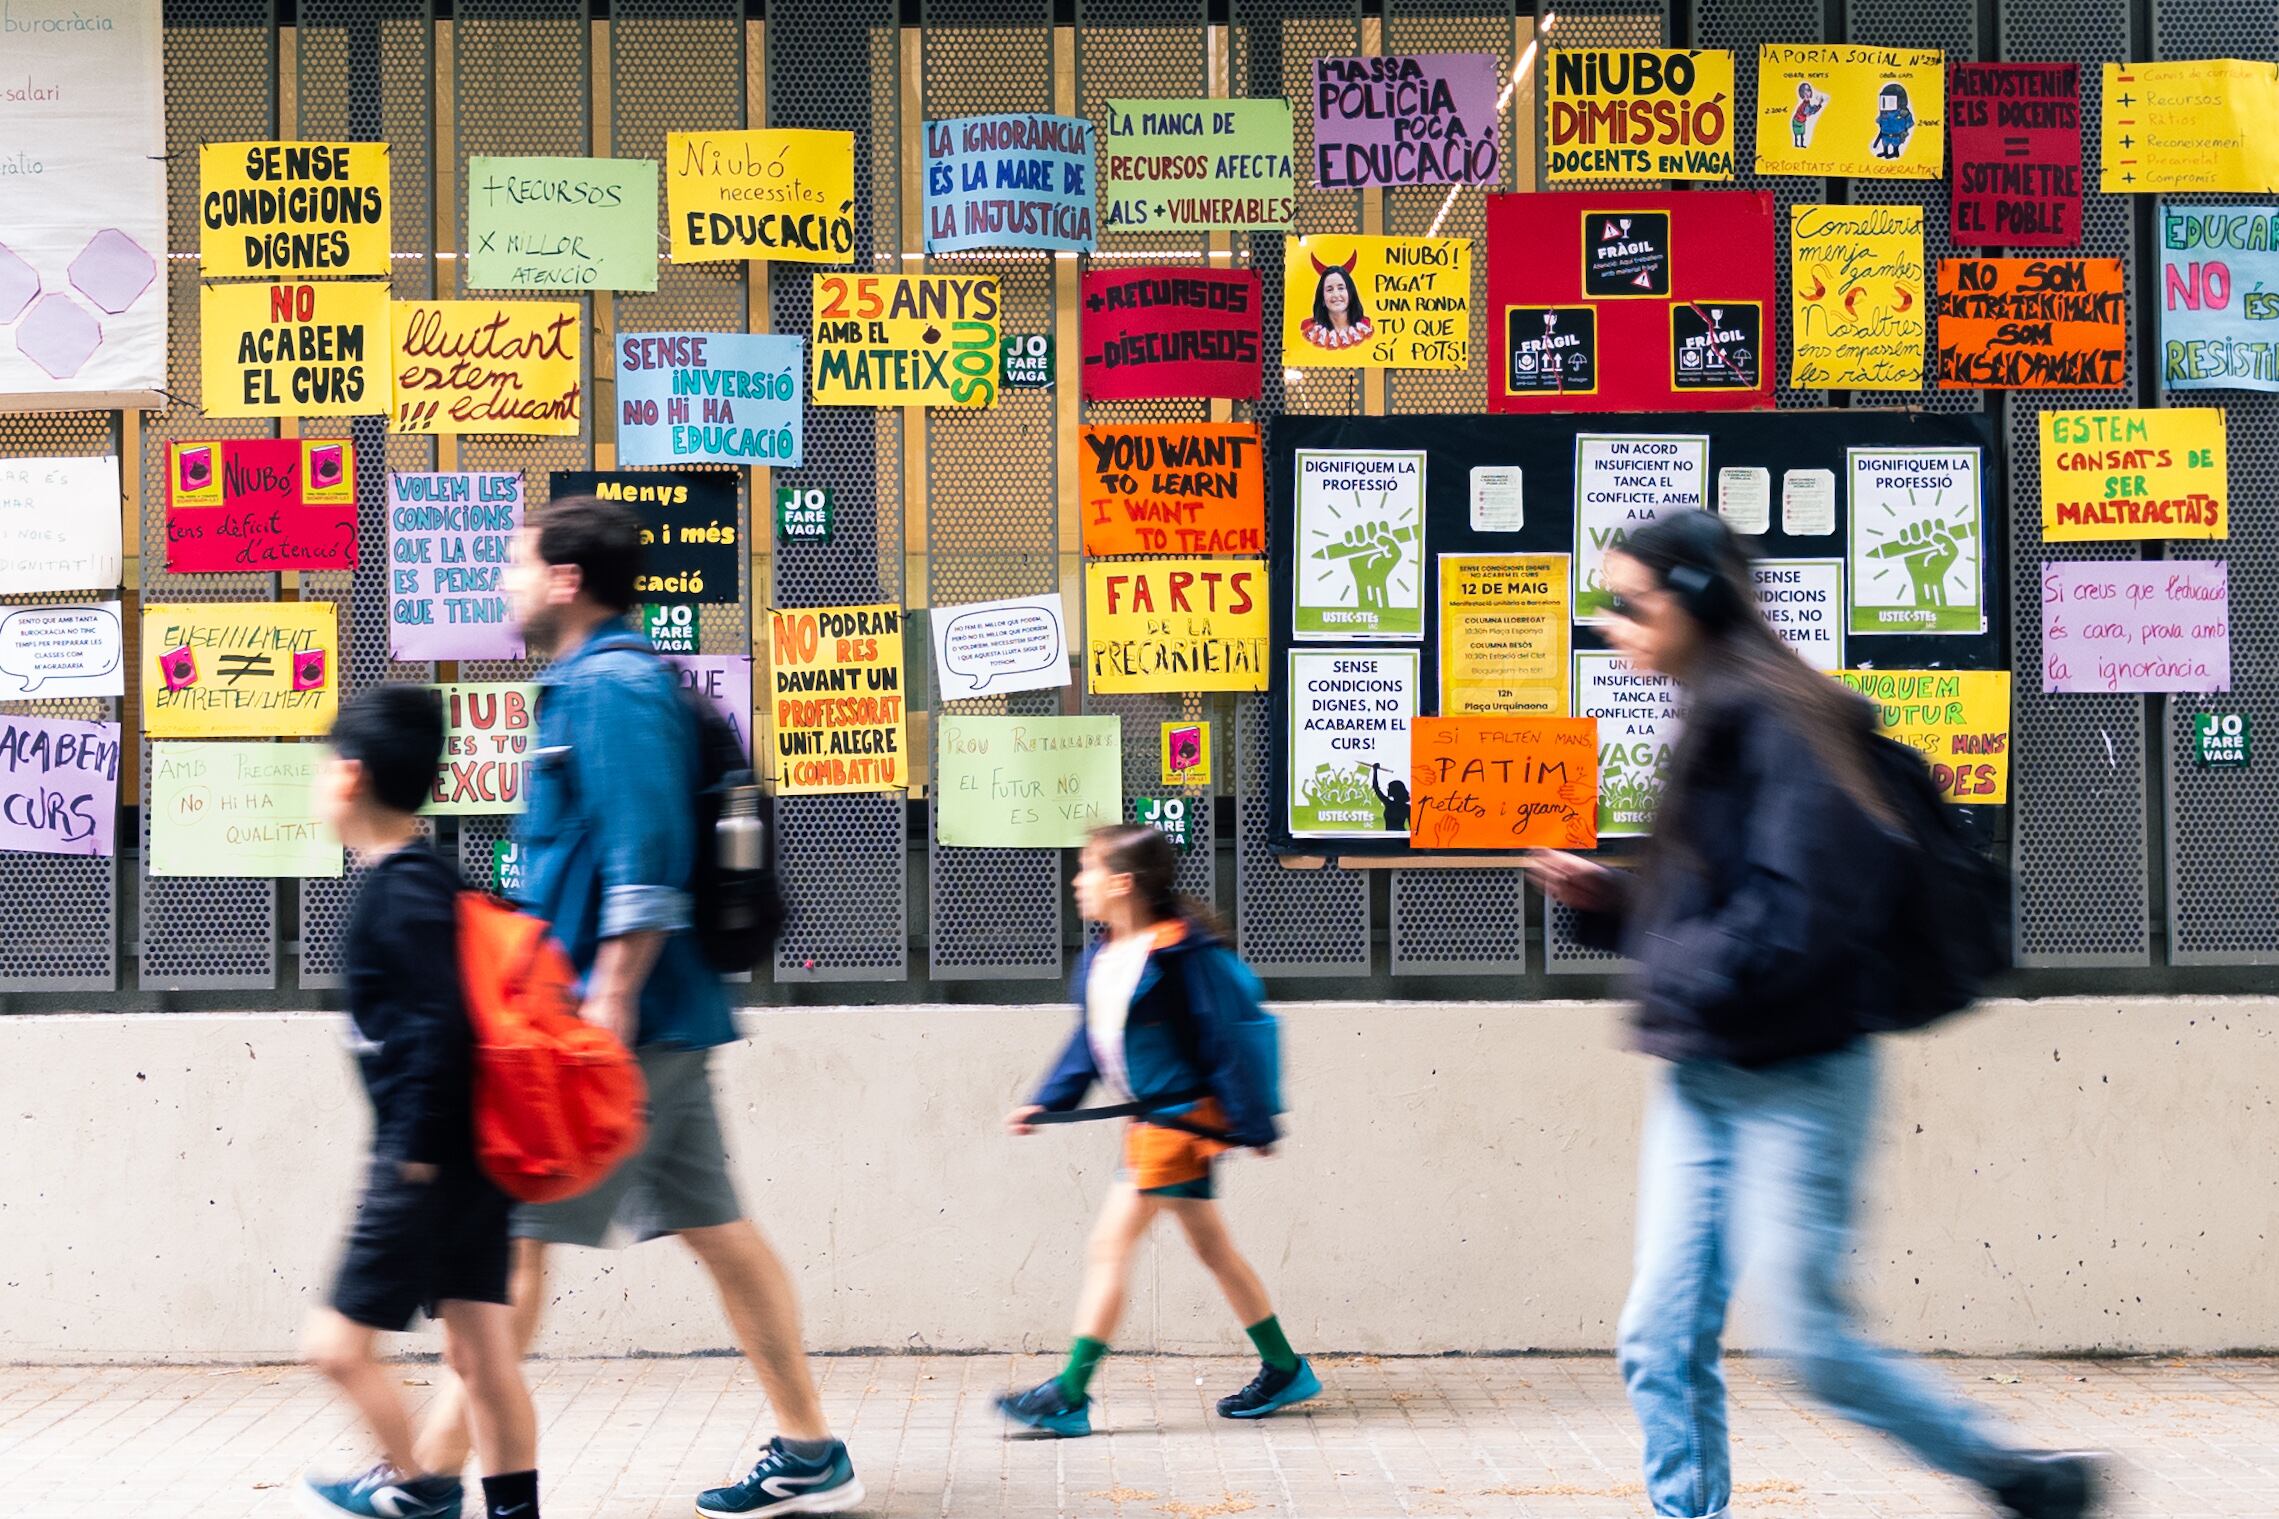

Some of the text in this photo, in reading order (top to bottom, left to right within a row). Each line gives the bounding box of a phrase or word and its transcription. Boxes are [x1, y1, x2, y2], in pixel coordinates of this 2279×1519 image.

[5, 0, 113, 32] burocràcia
[1318, 57, 1423, 83] MASSA
[2147, 90, 2223, 106] Recursos
[1109, 112, 1235, 136] LA MANCA DE
[1394, 115, 1467, 141] POCA
[1953, 101, 2077, 129] ELS DOCENTS
[929, 125, 954, 158] LA
[246, 146, 350, 181] SENSE
[679, 140, 790, 177] Niubó
[1110, 155, 1292, 181] RECURSOS AFECTA
[1553, 149, 1733, 174] DOCENTS EN VAGA
[929, 160, 1086, 196] ÉS LA MARE DE
[1961, 162, 2079, 198] SOTMETRE
[720, 180, 826, 204] necessites
[687, 200, 854, 254] EDUCACIÓ
[932, 204, 957, 240] LA
[1958, 201, 2066, 235] EL POBLE
[1597, 241, 1654, 260] FRÀGIL
[1799, 244, 1878, 272] menja
[1375, 273, 1436, 292] PAGA'T
[1838, 249, 1922, 295] gambes
[1958, 261, 2087, 292] NO SOM
[820, 277, 1000, 321] 25 ANYS
[2166, 261, 2230, 312] NO
[270, 284, 315, 323] NO
[1377, 298, 1410, 311] UNA
[817, 321, 889, 344] AMB EL
[1378, 318, 1454, 336] TU QUE
[1801, 304, 1923, 337] Nosaltres
[238, 325, 364, 364] ACABEM
[400, 308, 576, 361] lluitant
[1007, 335, 1048, 357] JO
[1986, 322, 2053, 350] SOM
[622, 336, 708, 371] SENSE
[950, 321, 998, 404] SOU
[1007, 356, 1048, 370] FARÉ
[1412, 342, 1467, 362] POTS!
[1798, 340, 1922, 365] ens empassem
[399, 355, 523, 392] estem
[1007, 370, 1048, 382] VAGA
[1796, 360, 1923, 382] les ràtios
[243, 366, 364, 405] EL CURS
[449, 381, 581, 423] educant
[623, 400, 659, 425] NO
[703, 398, 734, 425] HA
[2053, 416, 2149, 444] ESTEM
[1084, 434, 1257, 473] YOU WANT
[1611, 443, 1678, 455] UN ACORD
[2057, 449, 2214, 472] CANSATS DE
[1305, 461, 1416, 475] DIGNIFIQUEM LA
[1594, 459, 1694, 471] INSUFICIENT NO
[395, 476, 517, 501] VOLEM LES
[1100, 472, 1237, 499] TO LEARN
[1322, 476, 1398, 491] PROFESSIÓ
[2104, 476, 2149, 499] SER
[1091, 499, 1204, 525] I WANT
[2057, 494, 2220, 527] MALTRACTATS
[167, 518, 203, 542] tens
[1135, 528, 1258, 553] TO TEACH
[1107, 572, 1252, 615] FARTS
[1461, 582, 1548, 595] 12 DE MAIG
[2044, 575, 2064, 604] Si
[2074, 582, 2117, 600] creus
[2126, 583, 2154, 608] que
[773, 611, 899, 665] NO PODRAN
[2049, 616, 2227, 648] és cara, prova amb
[837, 639, 878, 663] RES
[777, 667, 897, 692] DAVANT UN
[1333, 660, 1379, 673] SENSE
[2048, 653, 2211, 690] la ignorància
[1307, 679, 1403, 693] CONDICIONS
[1497, 689, 1513, 698] 12h
[778, 696, 901, 728] PROFESSORAT
[1312, 699, 1399, 713] DIGNES, NO
[1464, 701, 1548, 712] Plaça Urquinaona
[1304, 718, 1407, 732] ACABAREM EL
[0, 724, 119, 782] ACABEM
[1331, 737, 1376, 751] CURS!
[4, 787, 97, 842] CURS
[1416, 790, 1579, 836] petits i grans
